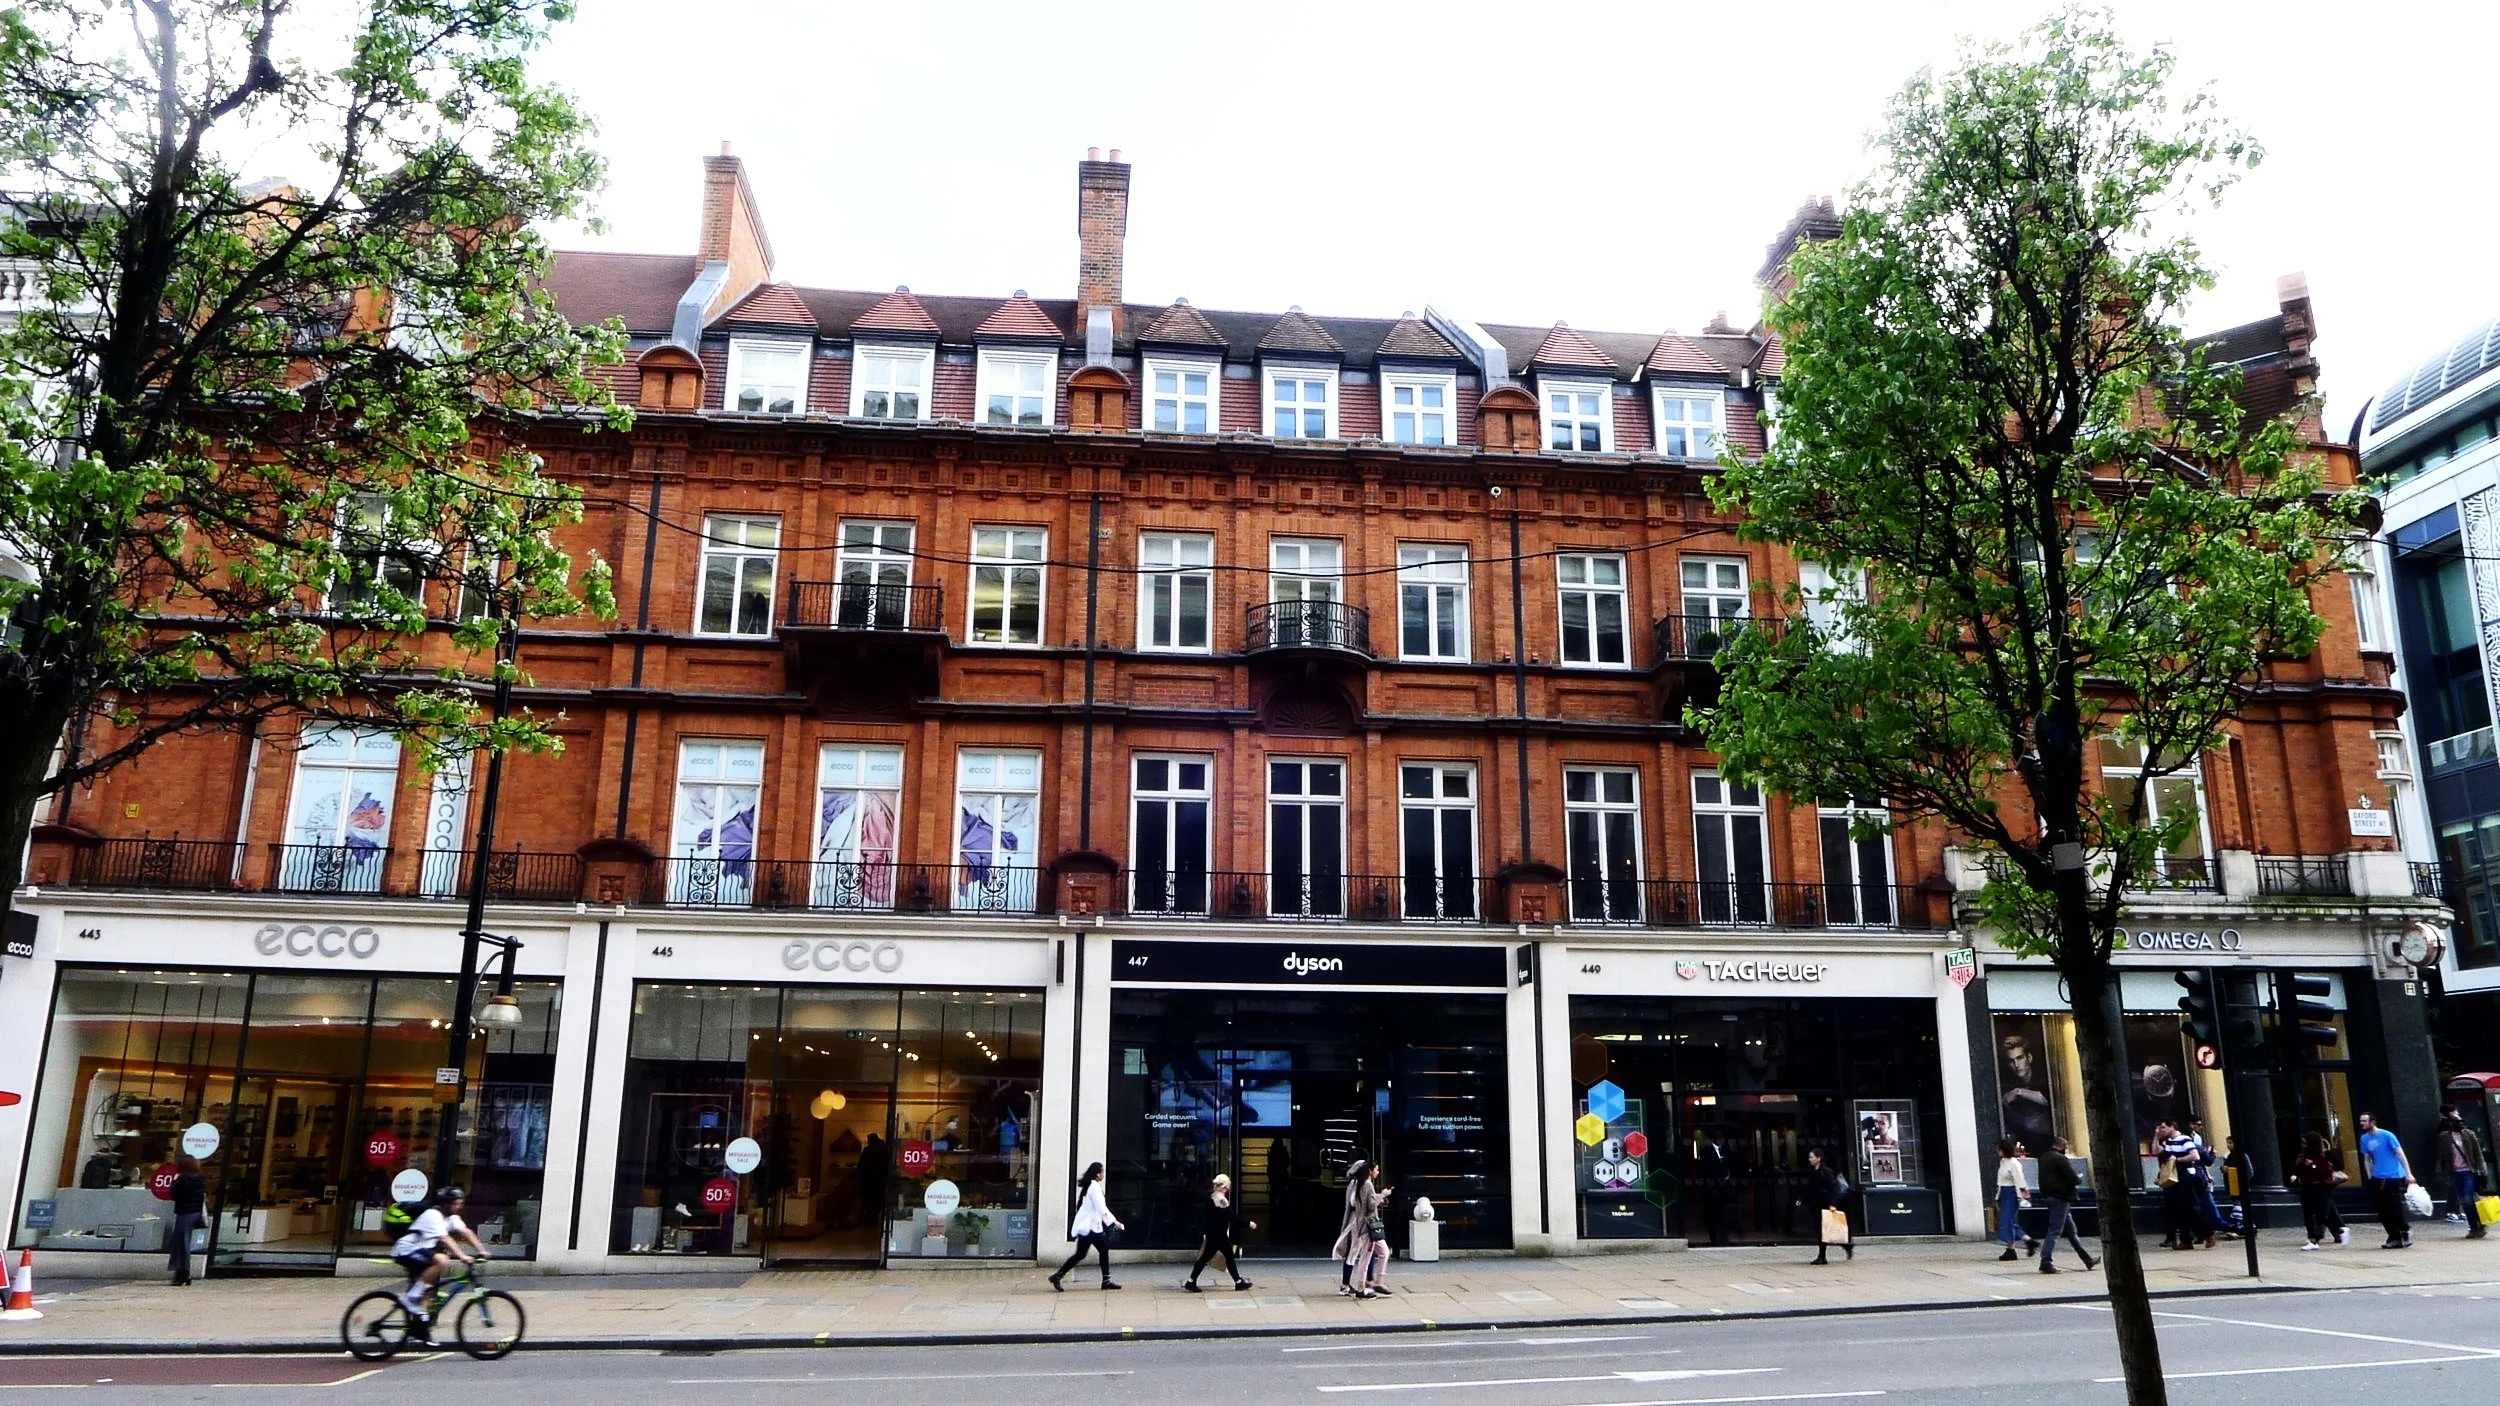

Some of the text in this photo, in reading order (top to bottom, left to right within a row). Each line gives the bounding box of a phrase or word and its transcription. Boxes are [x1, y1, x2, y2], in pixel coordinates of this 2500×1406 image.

[732, 759, 755, 767] ecco
[2354, 820, 2377, 828] STREET
[254, 923, 380, 960] ecco
[2138, 931, 2215, 950] OMEGA
[7, 941, 33, 956] ecco
[652, 945, 674, 958] 445
[782, 939, 904, 974] ecco
[1128, 956, 1149, 967] 447
[1283, 951, 1343, 976] dyson
[1949, 951, 1973, 966] TAG
[1581, 964, 1602, 975] 449
[904, 1150, 929, 1163] 50%
[155, 1173, 180, 1188] 50
[706, 1188, 732, 1201] 50%
